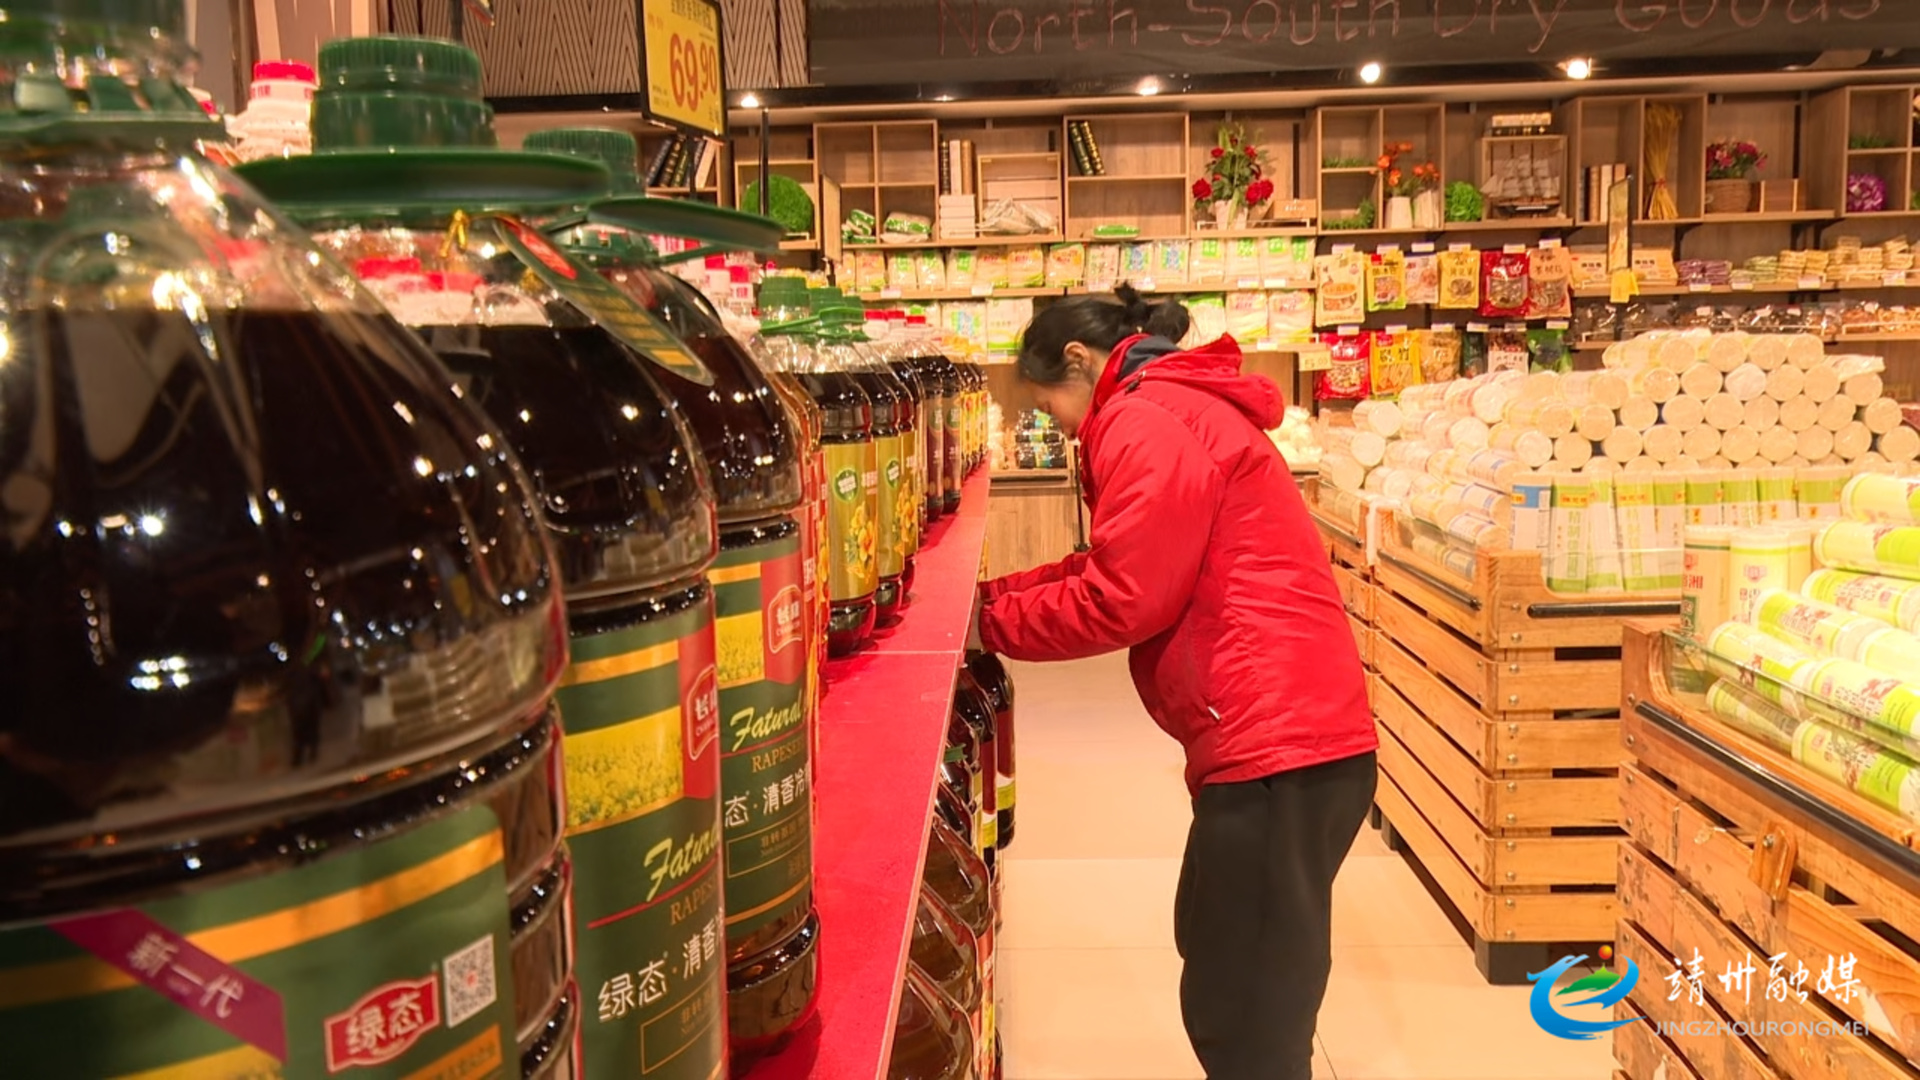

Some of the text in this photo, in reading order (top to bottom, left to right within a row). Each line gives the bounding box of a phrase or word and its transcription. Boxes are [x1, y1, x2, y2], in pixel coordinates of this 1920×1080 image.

[937, 0, 1399, 55] North-South
[669, 33, 718, 112] 69.90
[127, 931, 244, 1019] 新一代
[345, 991, 424, 1055] 绿态
